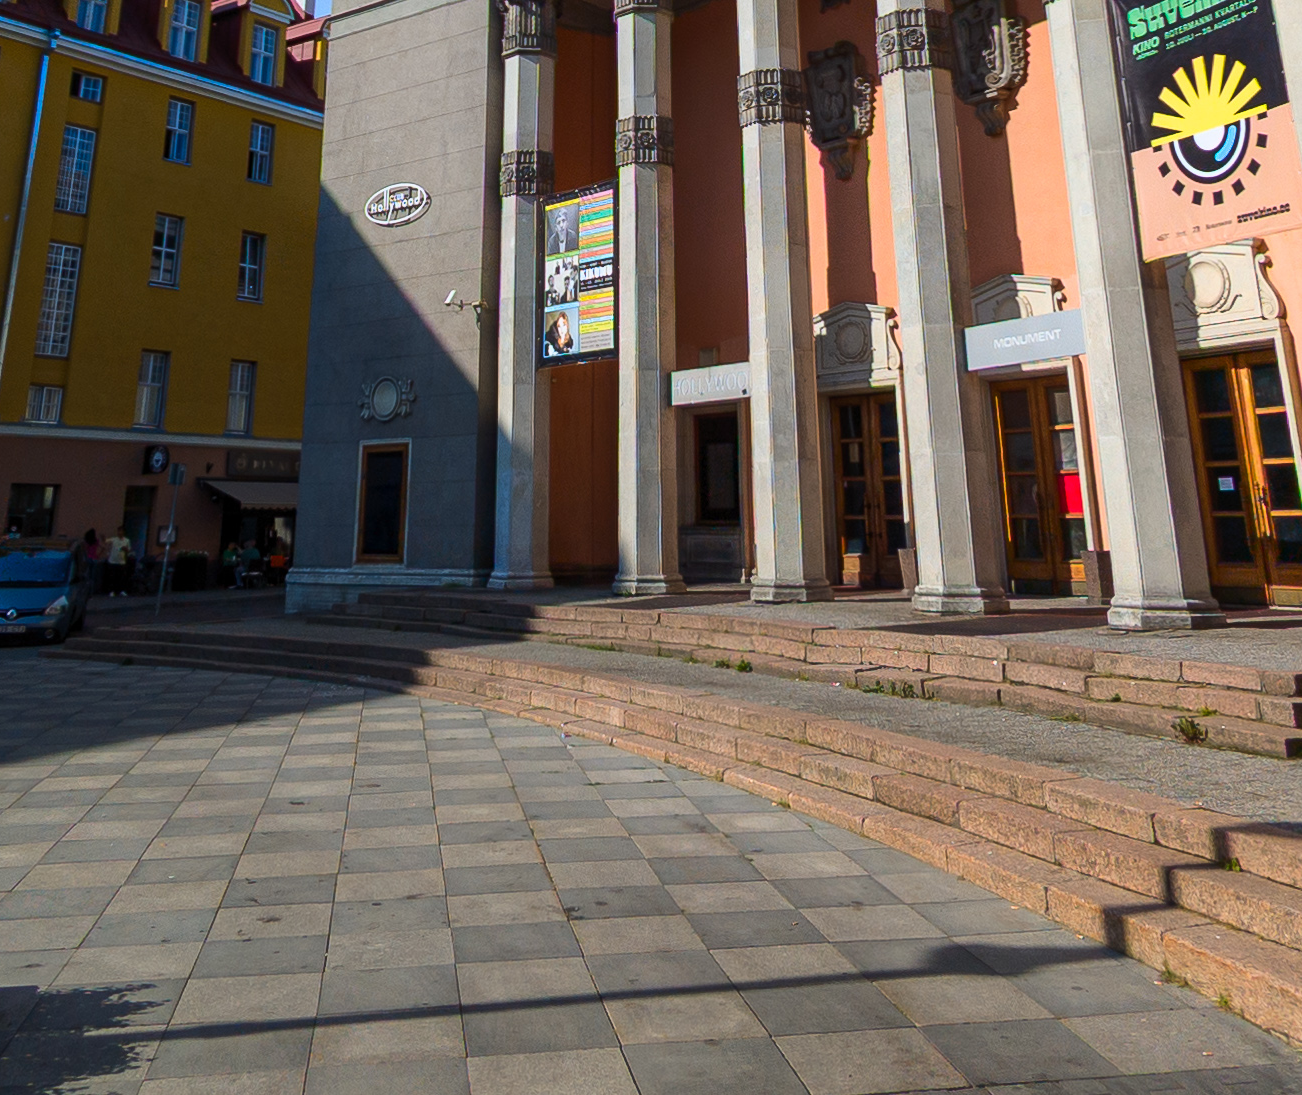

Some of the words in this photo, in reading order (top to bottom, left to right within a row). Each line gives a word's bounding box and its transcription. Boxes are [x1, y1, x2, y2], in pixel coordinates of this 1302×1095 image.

[1132, 35, 1161, 56] KINO
[370, 188, 421, 223] Hollywood
[993, 328, 1062, 350] MONUMENT
[672, 370, 752, 397] HOLLYWOO
